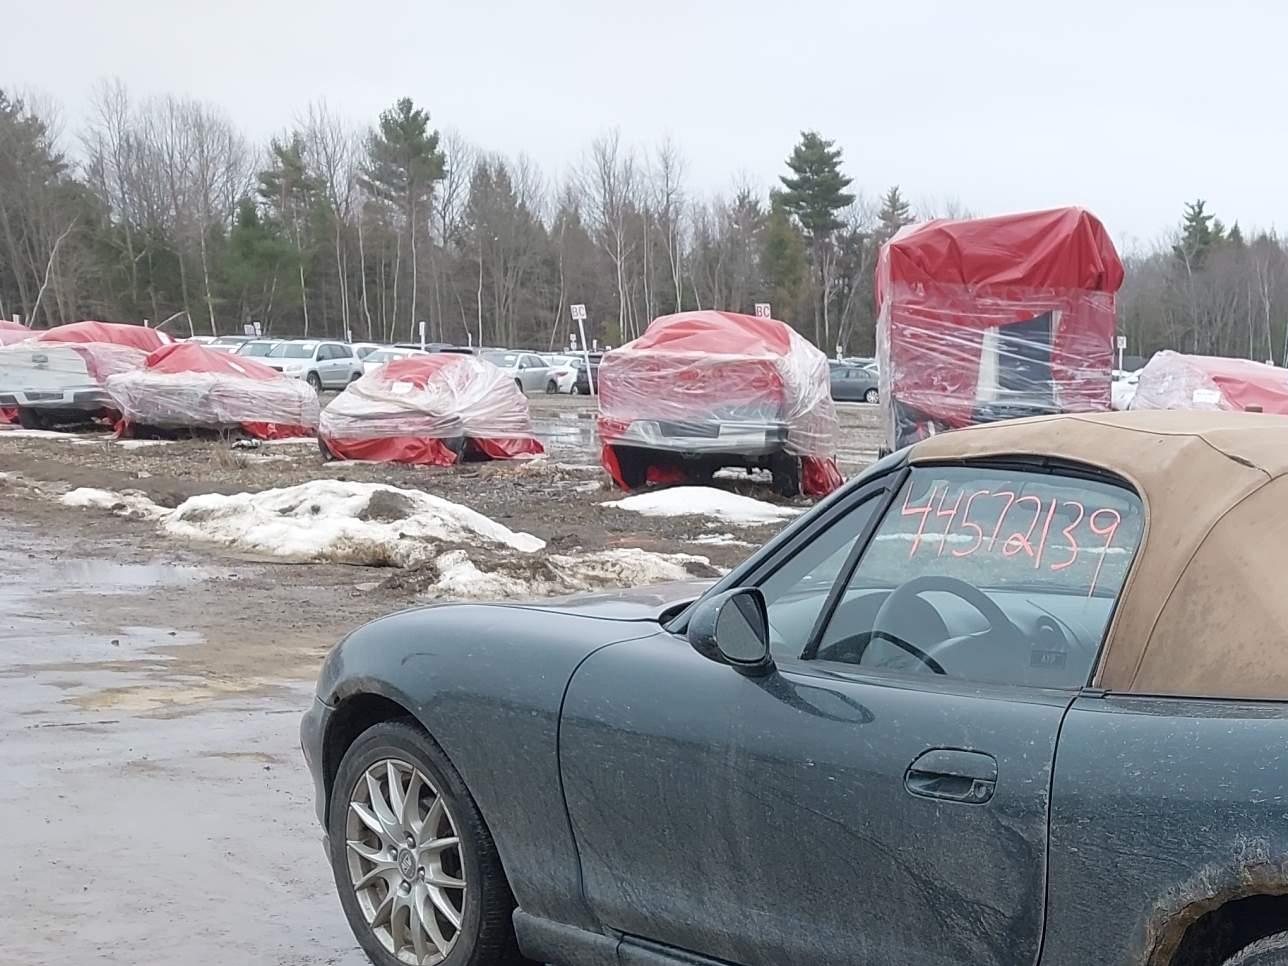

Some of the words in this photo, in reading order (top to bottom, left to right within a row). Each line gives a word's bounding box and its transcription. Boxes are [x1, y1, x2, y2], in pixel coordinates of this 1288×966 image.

[572, 307, 585, 317] BC
[756, 306, 770, 317] BC
[902, 481, 1121, 600] 44572139
